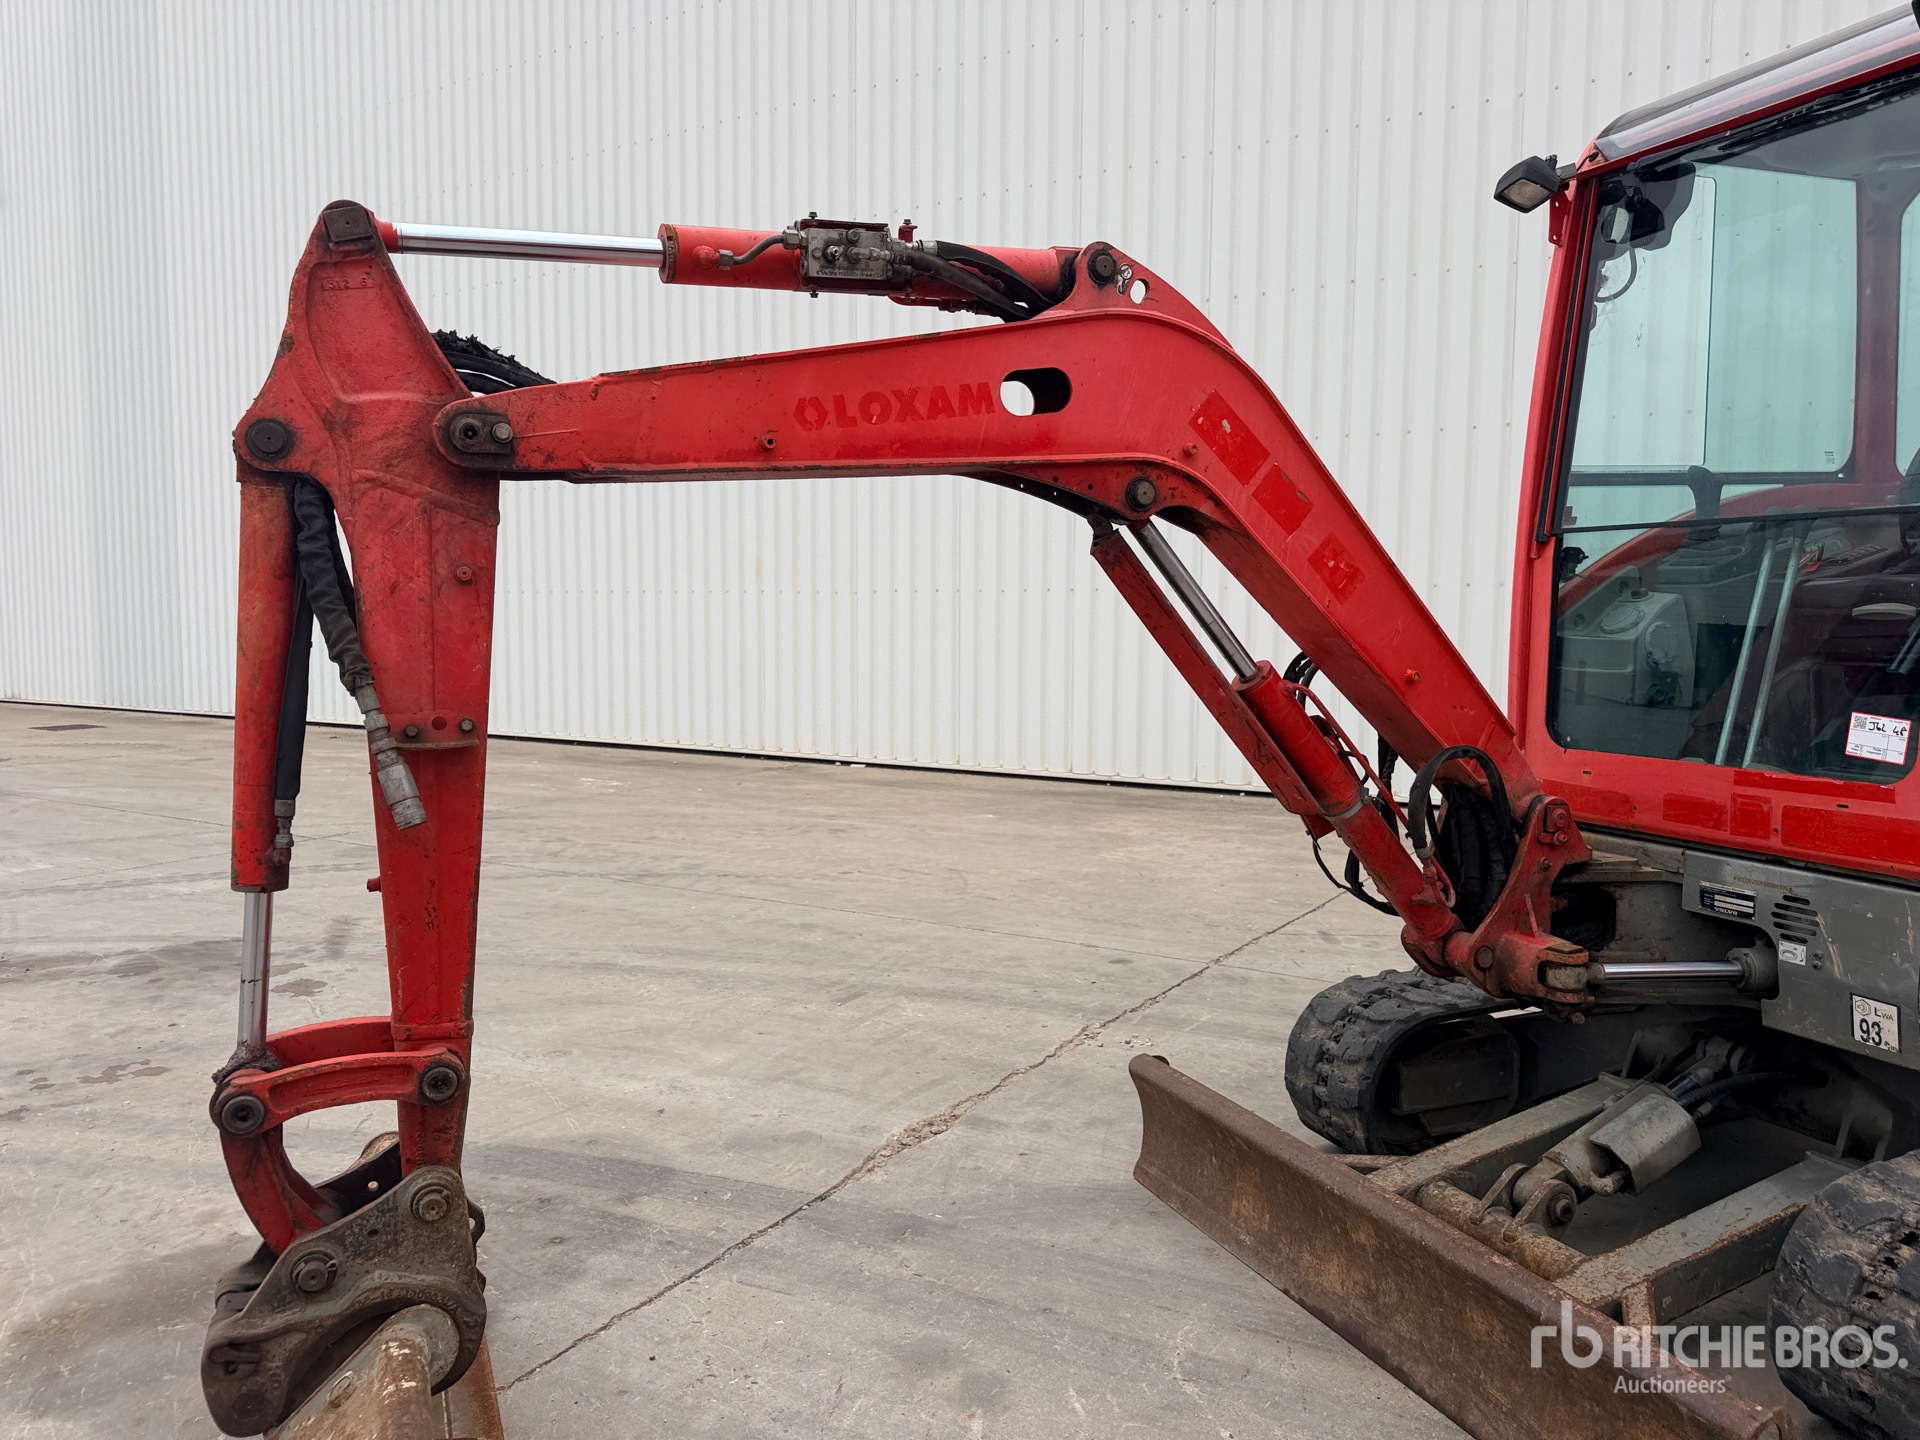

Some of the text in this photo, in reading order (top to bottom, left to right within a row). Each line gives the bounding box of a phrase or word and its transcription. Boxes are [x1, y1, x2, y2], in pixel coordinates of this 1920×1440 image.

[834, 382, 996, 428] LOXAM
[1714, 906, 1738, 916] VOLVO
[1859, 1017, 1882, 1046] 93
